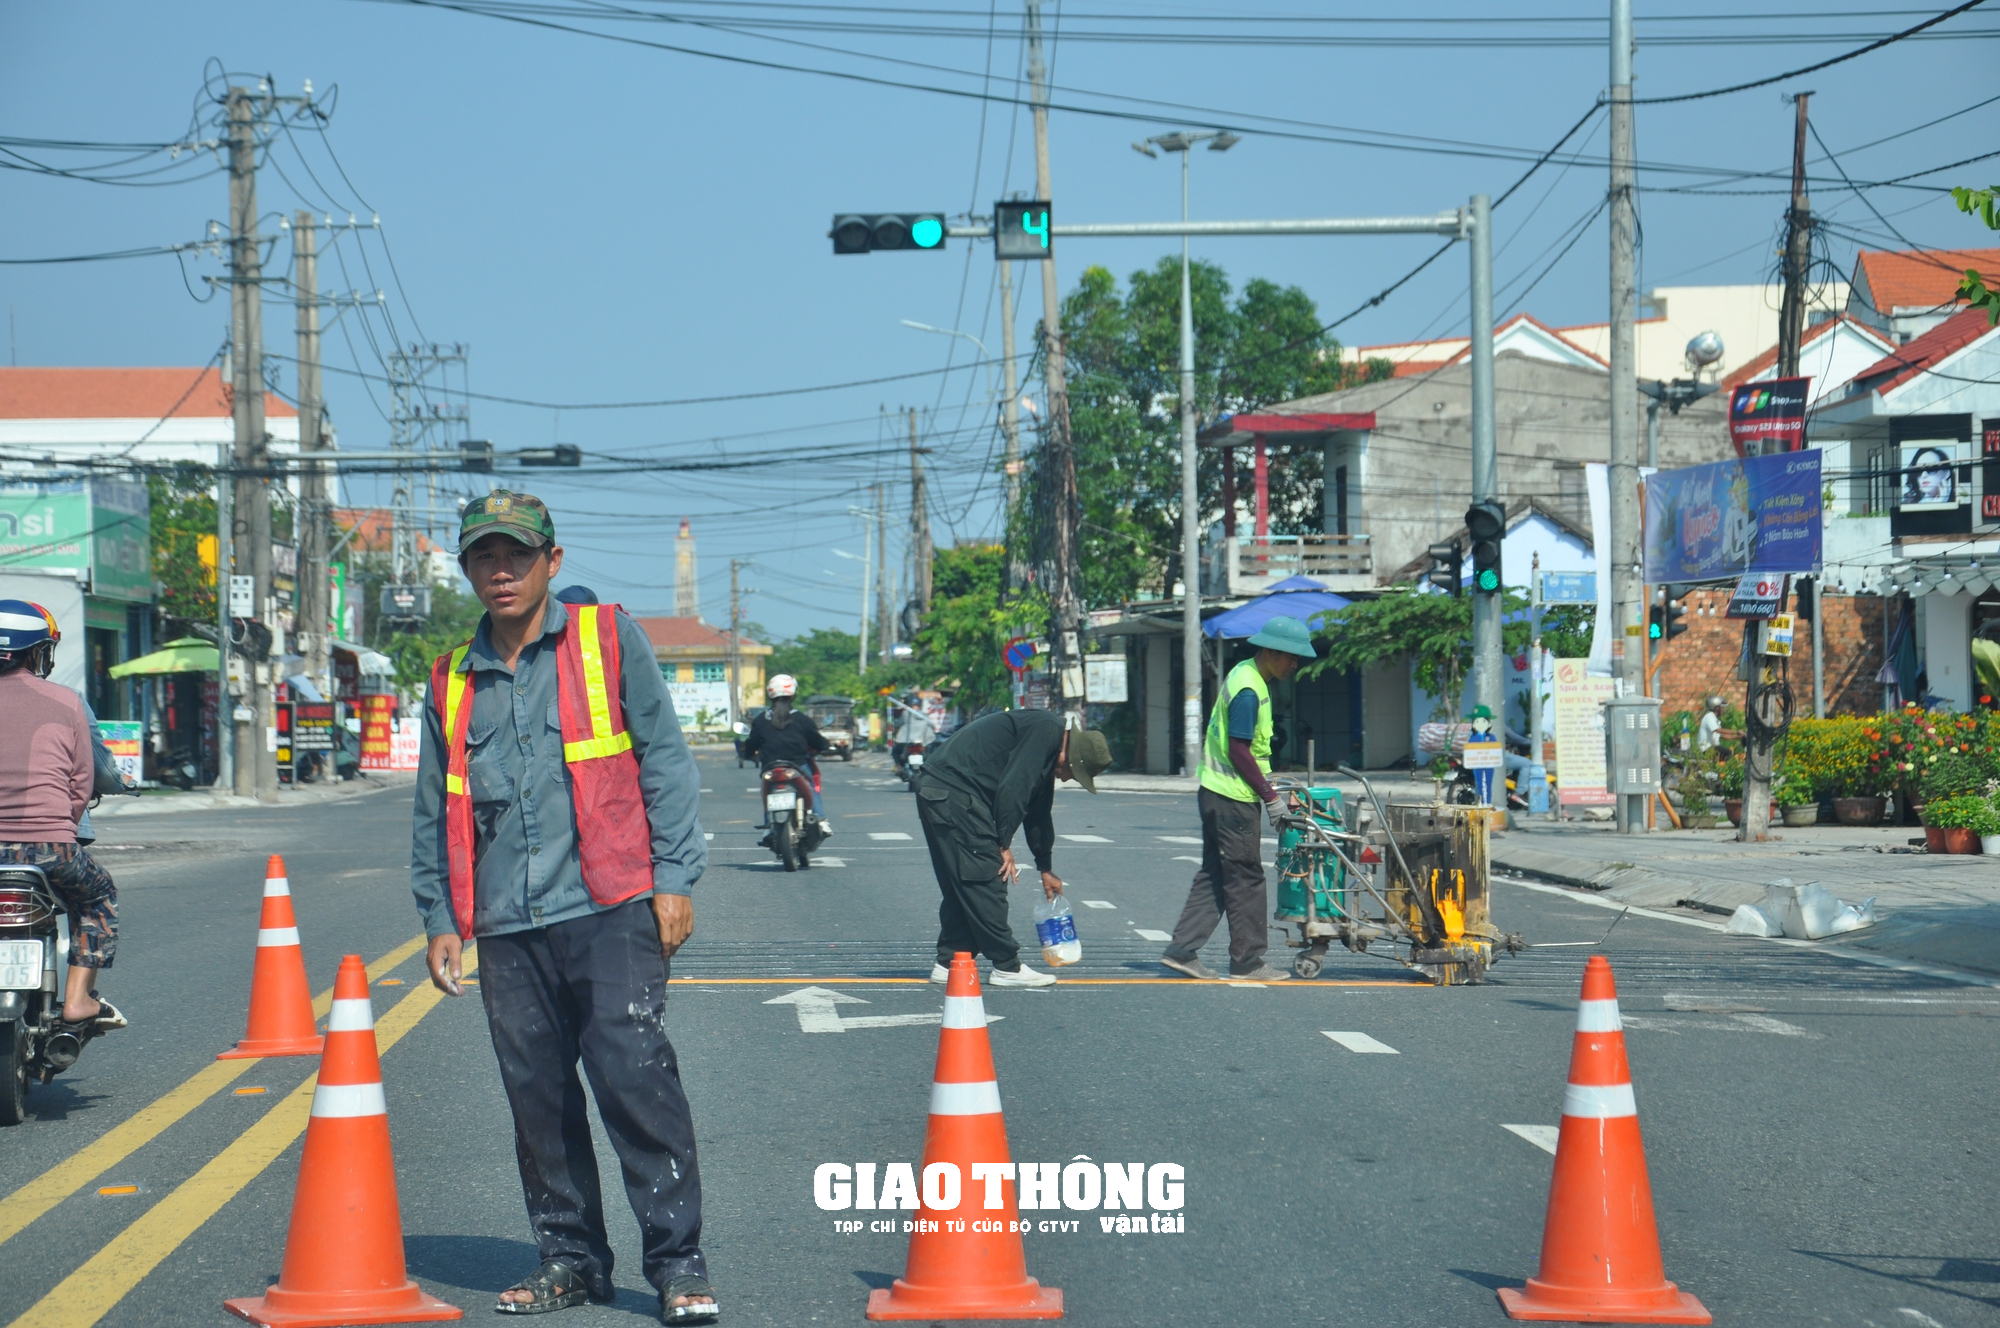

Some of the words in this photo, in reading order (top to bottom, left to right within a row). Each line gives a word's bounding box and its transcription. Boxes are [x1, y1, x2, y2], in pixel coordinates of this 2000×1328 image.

[1022, 211, 1048, 249] 4
[1736, 391, 1770, 411] FPT
[1734, 424, 1758, 434] Galaxy
[1773, 422, 1790, 431] Ultra
[1559, 684, 1578, 692] Spa
